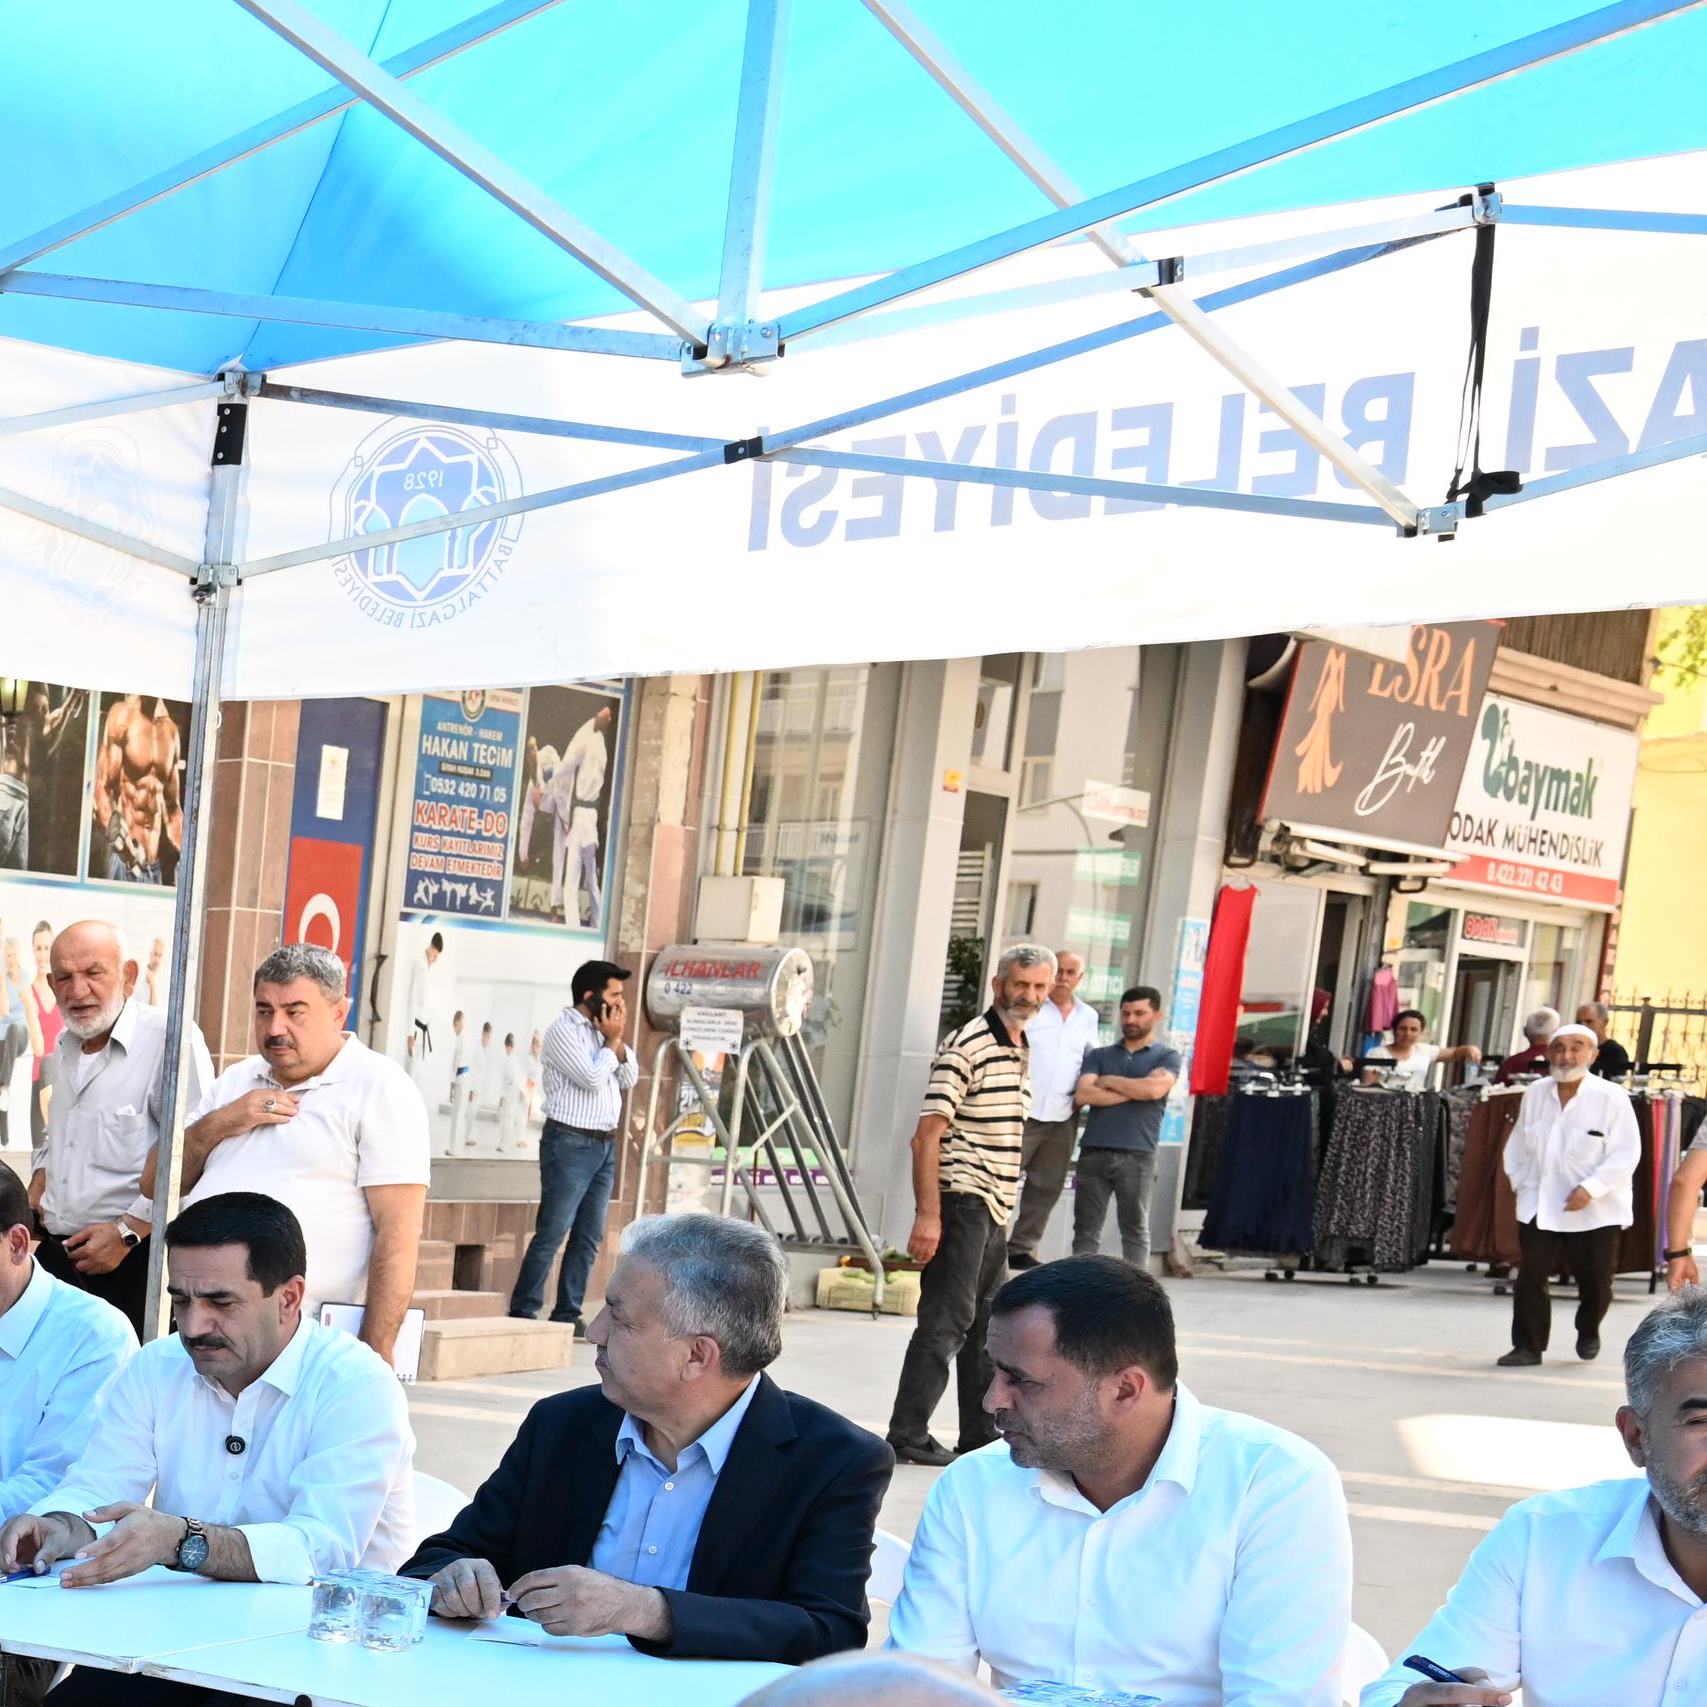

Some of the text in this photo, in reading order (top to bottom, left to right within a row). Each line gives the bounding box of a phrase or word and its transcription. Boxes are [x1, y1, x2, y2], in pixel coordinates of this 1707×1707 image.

[422, 734, 468, 762] HAKAN
[430, 777, 507, 803] 0532 420 71 05
[1500, 744, 1599, 820] baymak
[414, 800, 508, 839] KARATE-DO
[413, 832, 505, 859] KURS KAYITLARIMIZ
[1449, 811, 1604, 869] ODAK MÜHENDİSLİK
[410, 851, 504, 880] DEVAM ETMEKTEDİR
[1535, 871, 1548, 890] 42
[1550, 874, 1564, 893] 43
[664, 981, 672, 995] 0
[674, 981, 693, 996] 422
